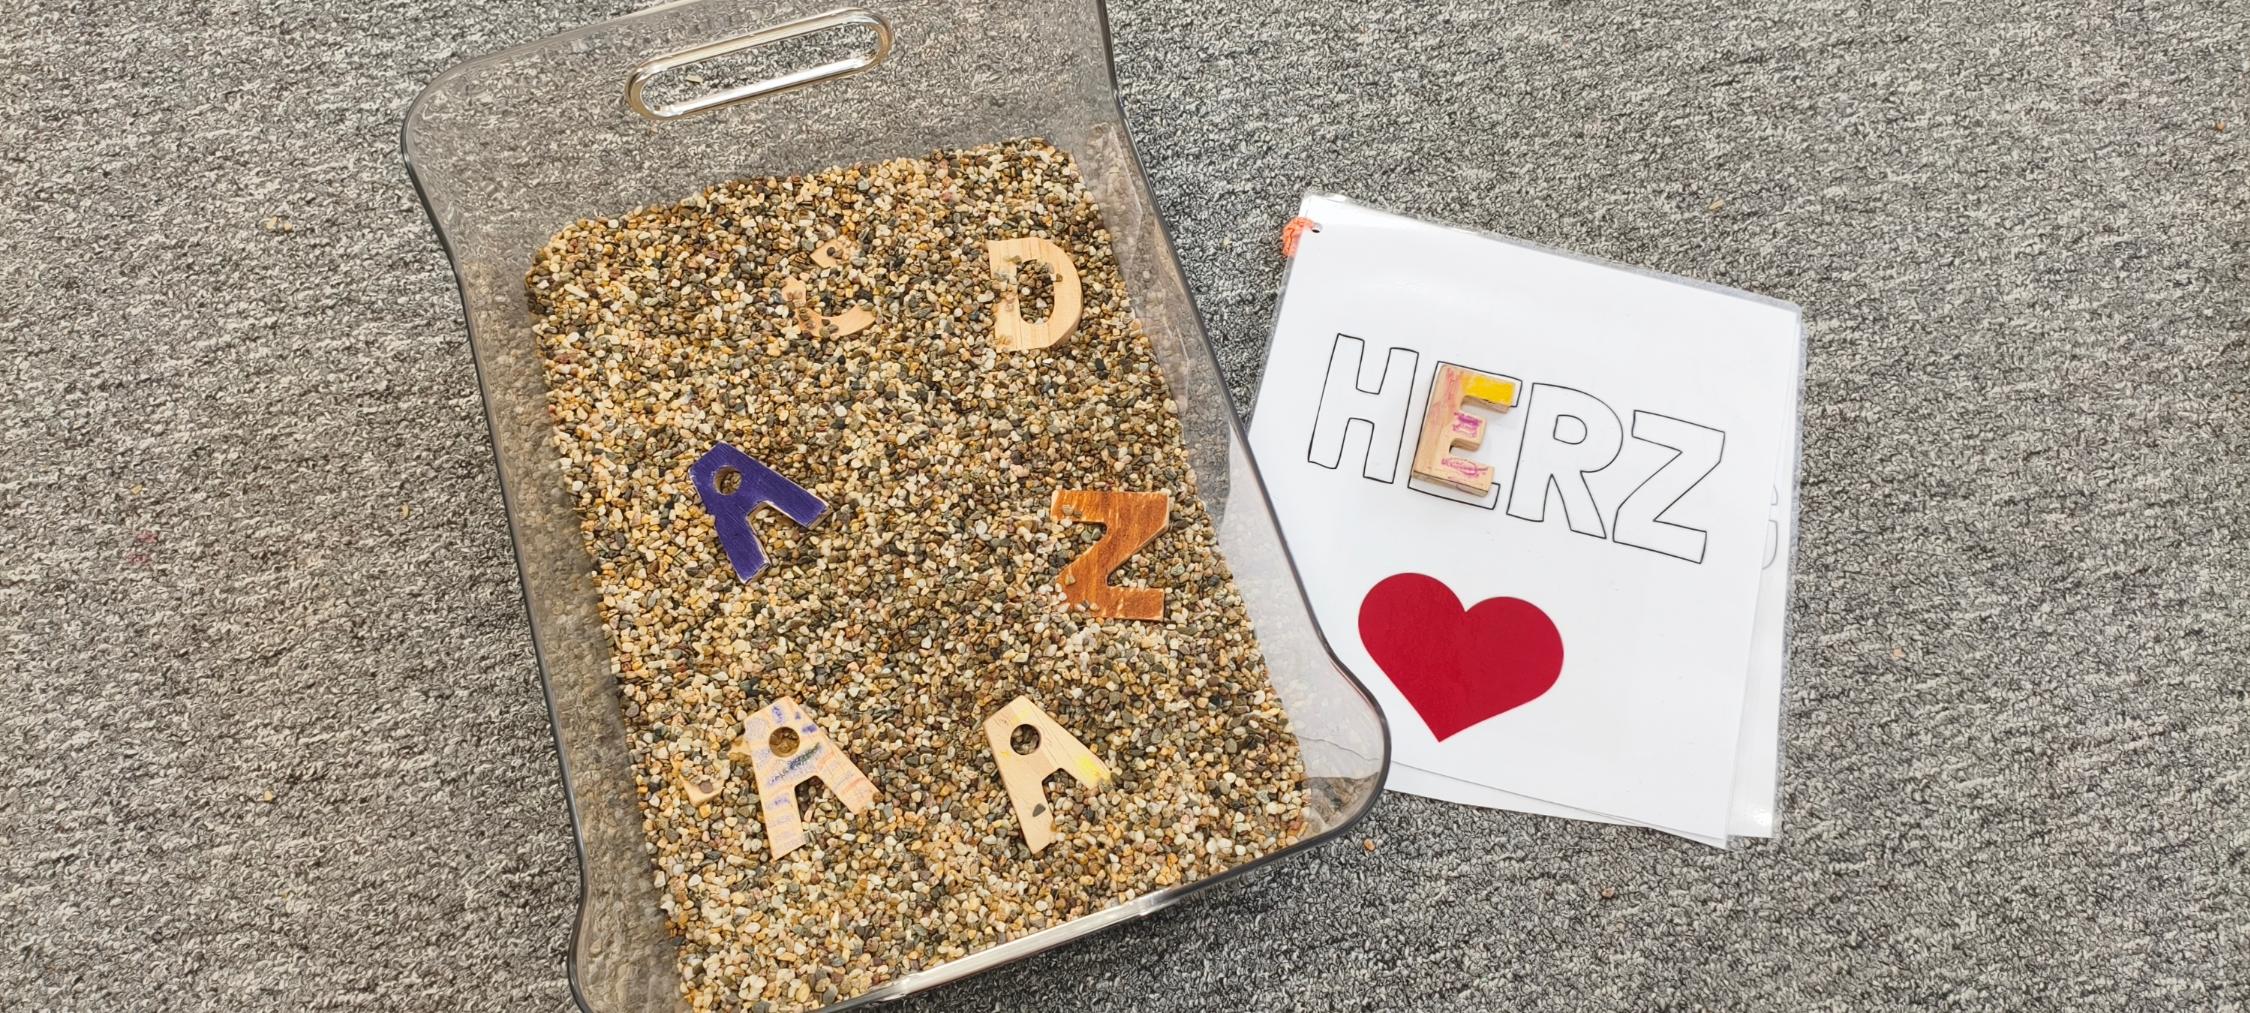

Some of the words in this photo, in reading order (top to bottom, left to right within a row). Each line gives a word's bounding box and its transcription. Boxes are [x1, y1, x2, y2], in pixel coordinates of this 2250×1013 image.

[988, 237, 1082, 350] D
[689, 440, 829, 583] A
[1307, 333, 1725, 564] HERZ
[1051, 490, 1170, 621] Z
[744, 696, 881, 860] A
[983, 695, 1110, 855] A
